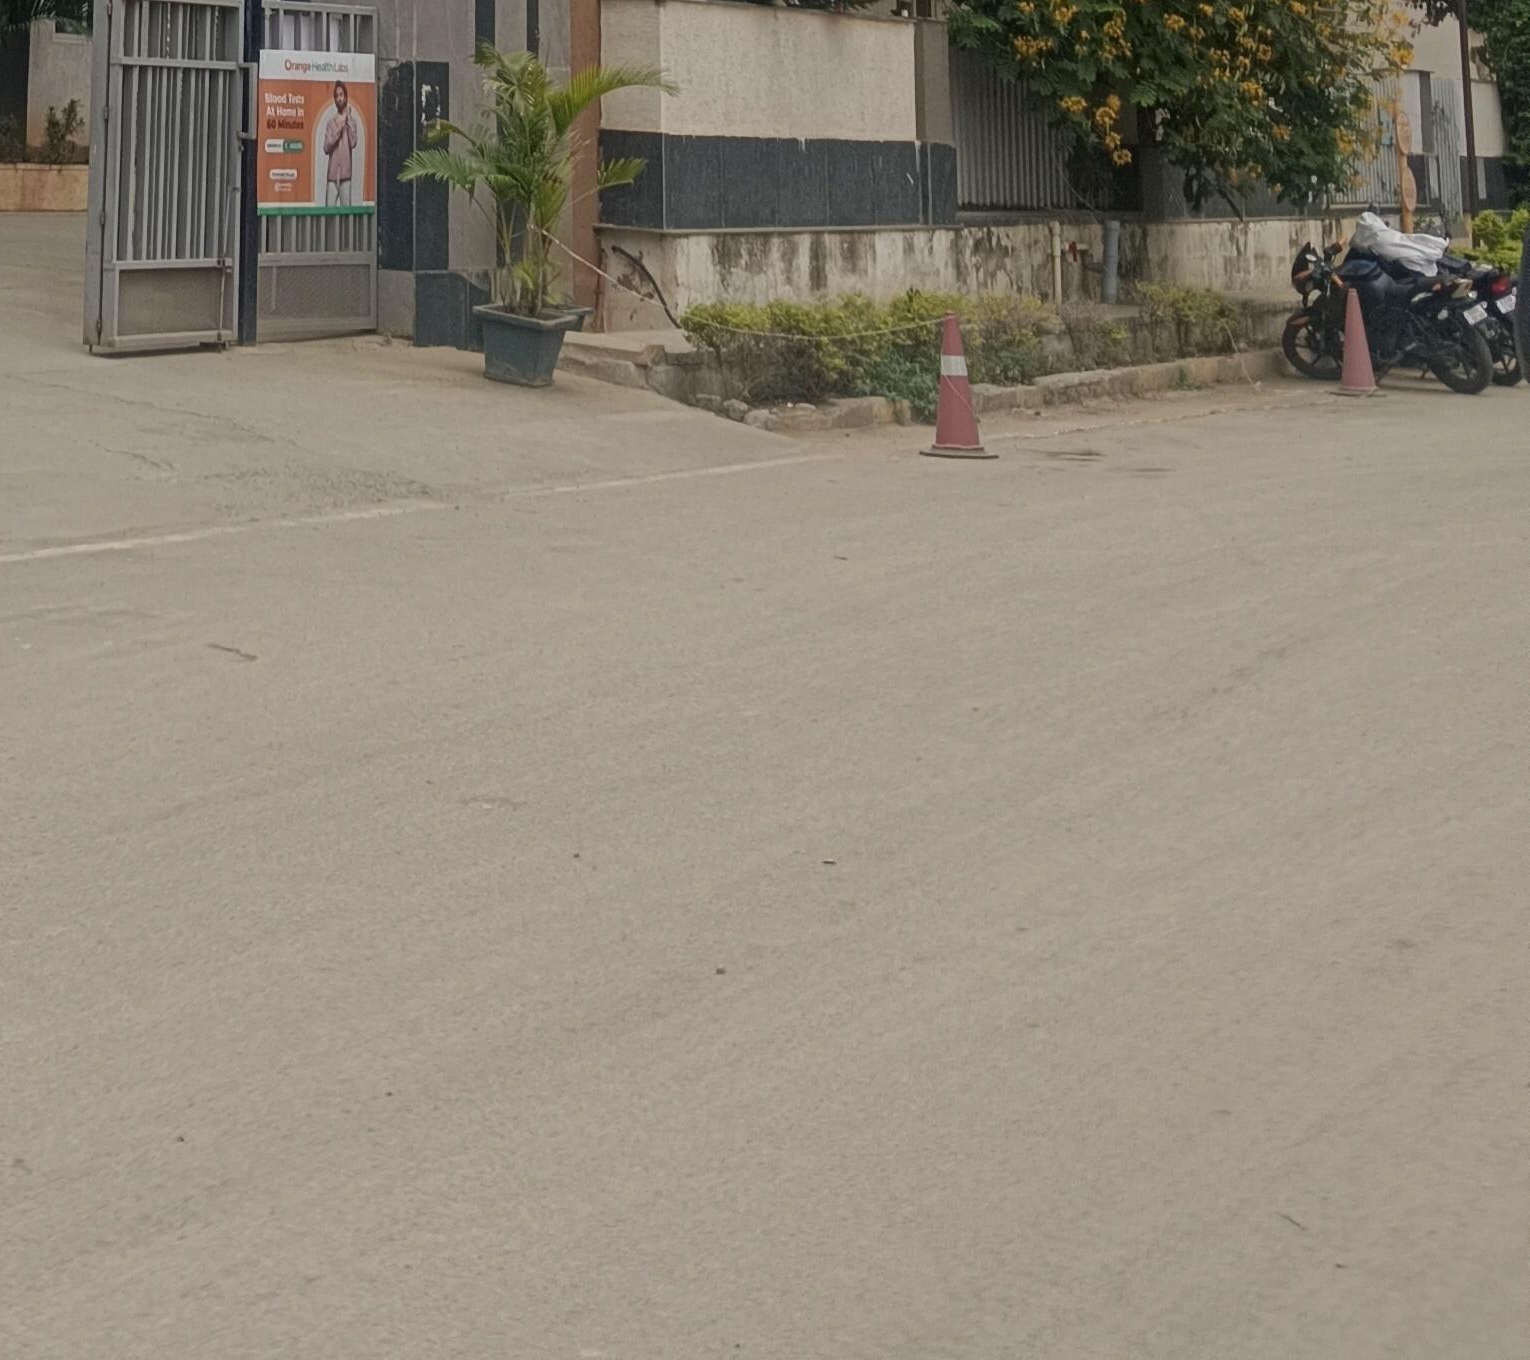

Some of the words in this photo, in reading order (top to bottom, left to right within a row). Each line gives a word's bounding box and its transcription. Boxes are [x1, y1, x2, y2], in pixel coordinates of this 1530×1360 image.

[284, 59, 311, 74] Orange
[264, 92, 287, 105] Blood
[288, 93, 305, 105] Tests
[266, 106, 276, 117] At
[276, 107, 296, 118] Home
[266, 119, 277, 130] 60
[277, 120, 304, 130] Minutes
